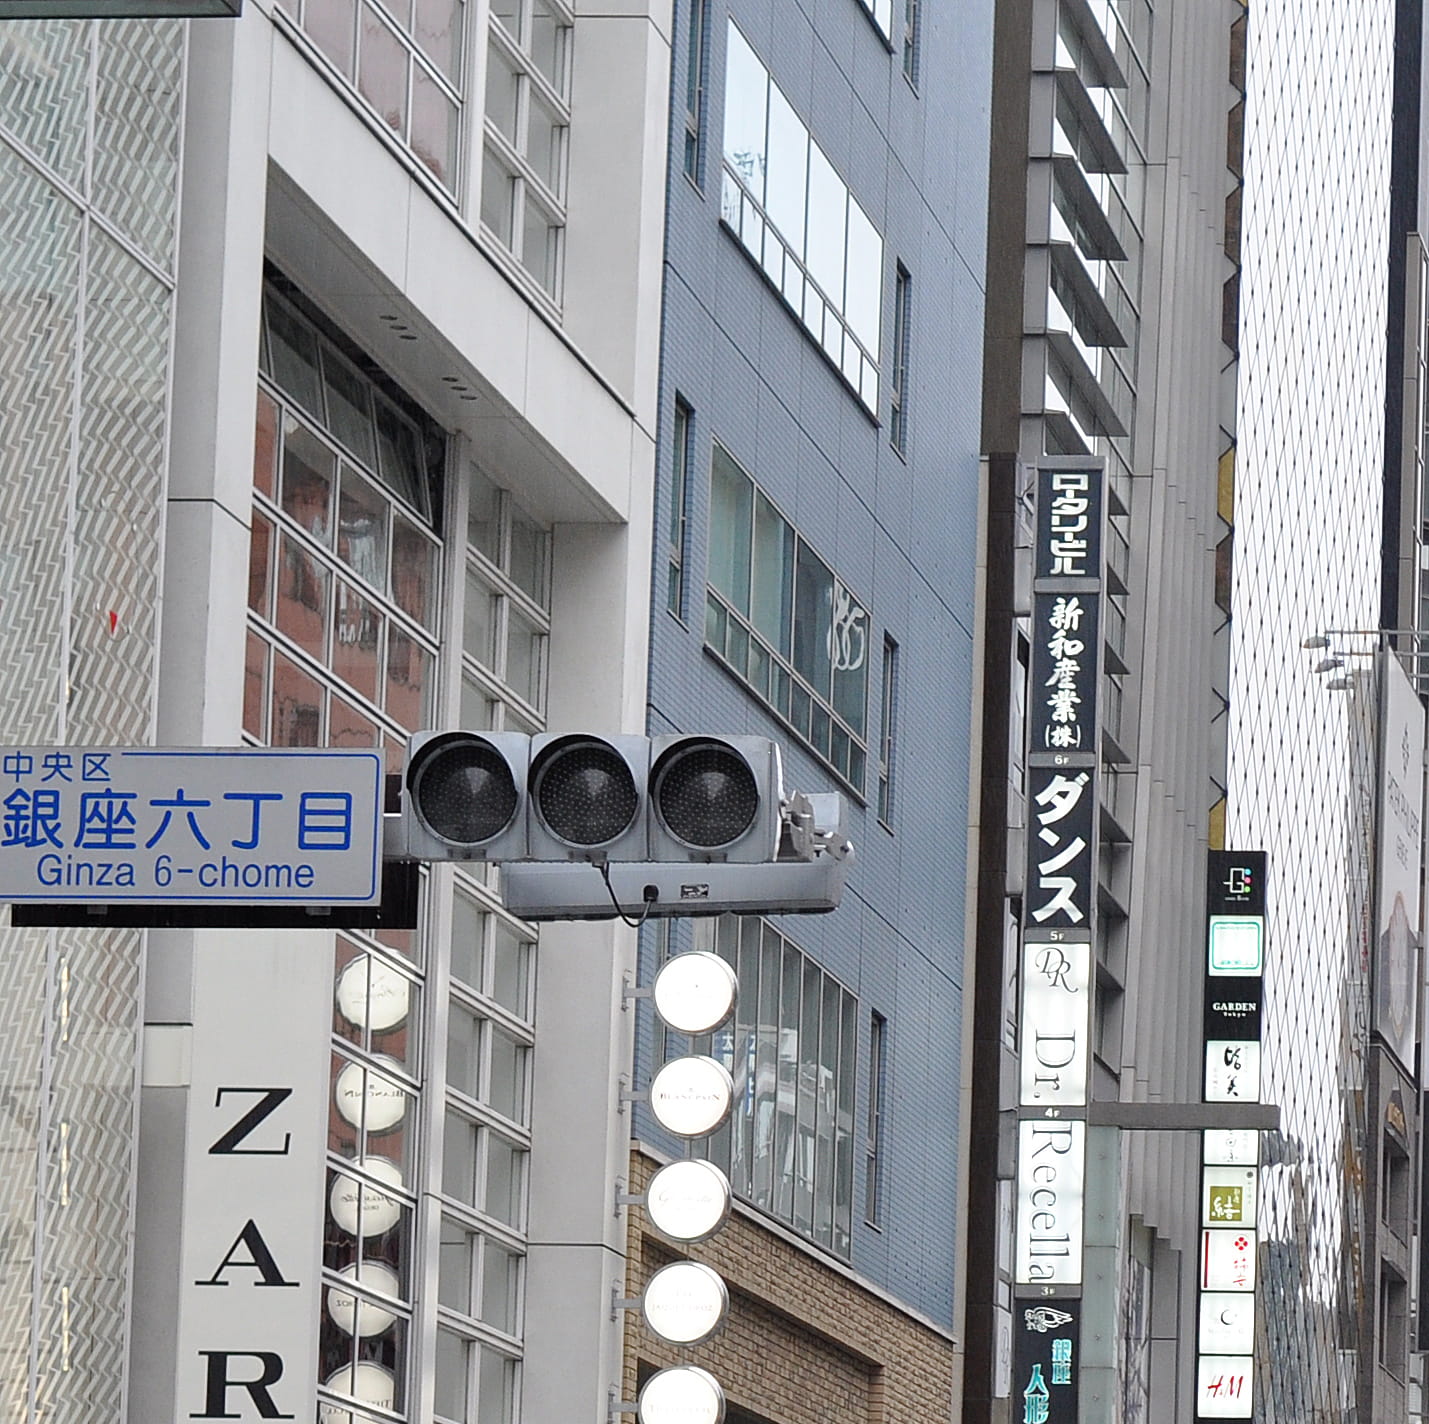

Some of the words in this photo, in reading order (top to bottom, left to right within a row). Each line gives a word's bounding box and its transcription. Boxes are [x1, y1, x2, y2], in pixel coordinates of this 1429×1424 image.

[3, 752, 111, 781] 中央区
[2, 787, 352, 851] 銀座六丁目
[1032, 772, 1089, 924] ダンス
[37, 855, 136, 888] Ginza
[154, 855, 315, 888] 6-chome
[1213, 1002, 1256, 1012] GARDEN
[1029, 1120, 1073, 1283] Recella
[1052, 1339, 1072, 1384] 銀座
